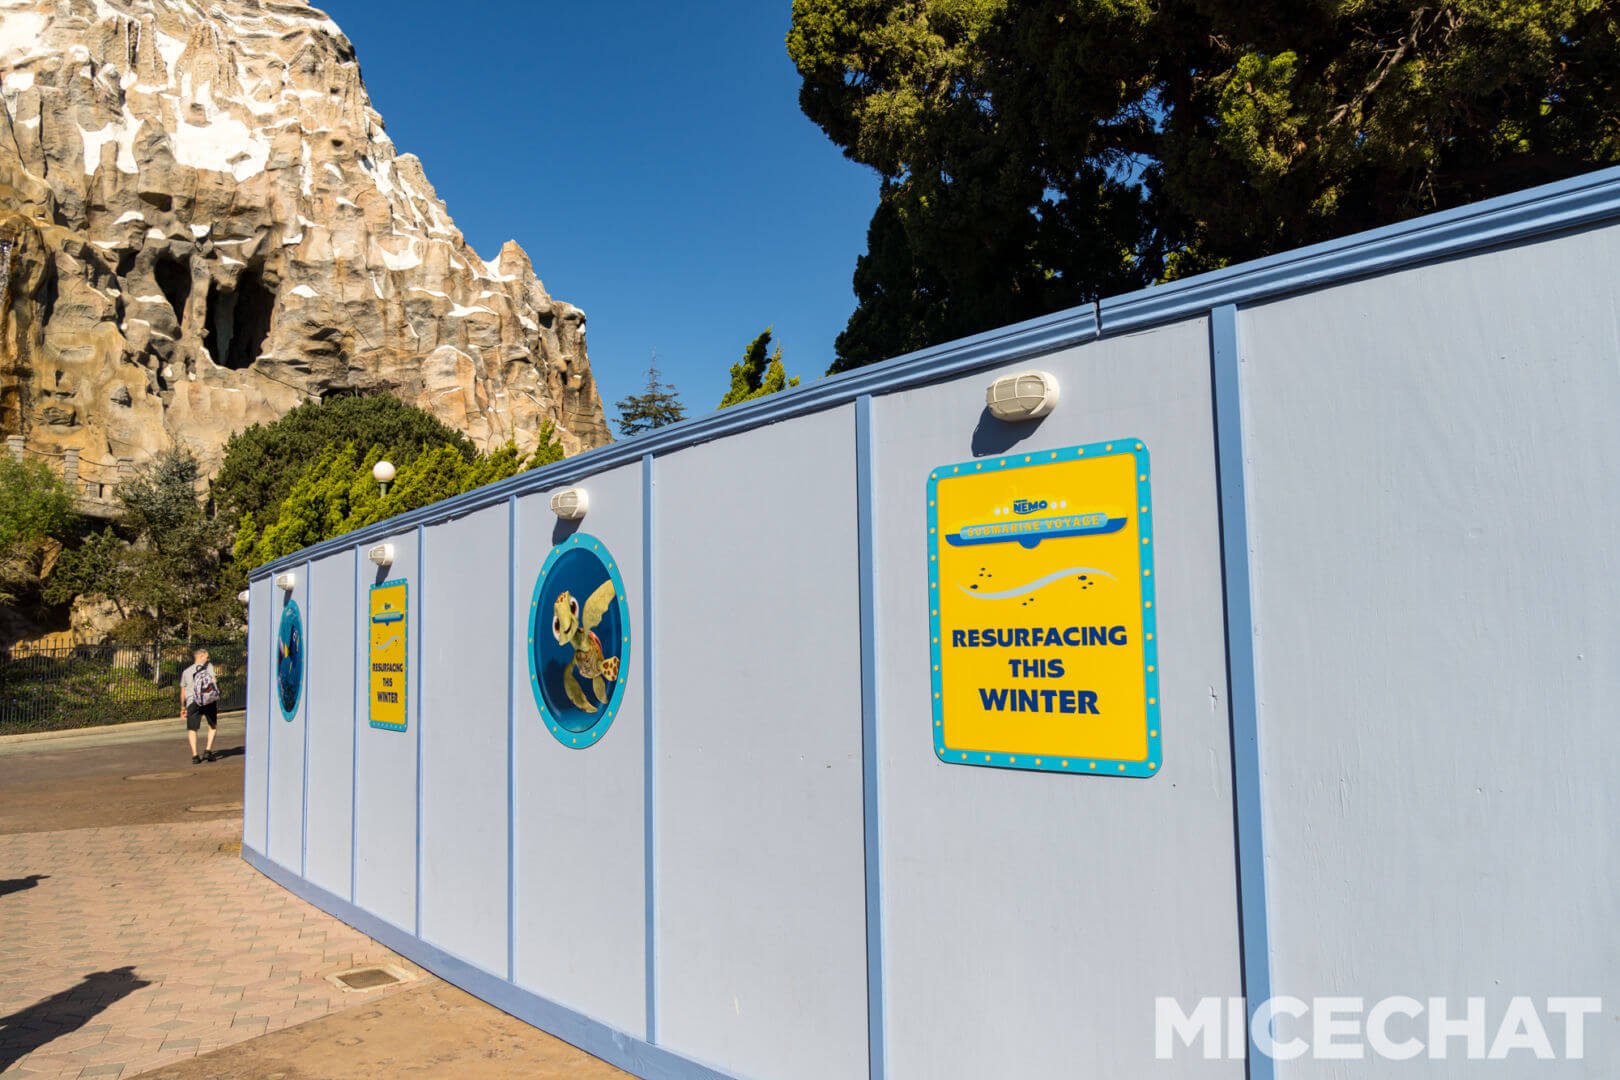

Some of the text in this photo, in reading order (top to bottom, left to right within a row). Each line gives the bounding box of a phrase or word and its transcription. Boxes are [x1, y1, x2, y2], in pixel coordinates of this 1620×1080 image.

[1013, 500, 1048, 514] NEMO
[967, 515, 1101, 537] SUBMARINE VOYAGE
[952, 626, 1128, 648] RESURFACING
[372, 663, 403, 672] RESURFACING
[1008, 658, 1066, 679] THIS
[382, 677, 393, 687] THIS
[377, 691, 399, 703] WINTER
[978, 688, 1101, 715] WINTER
